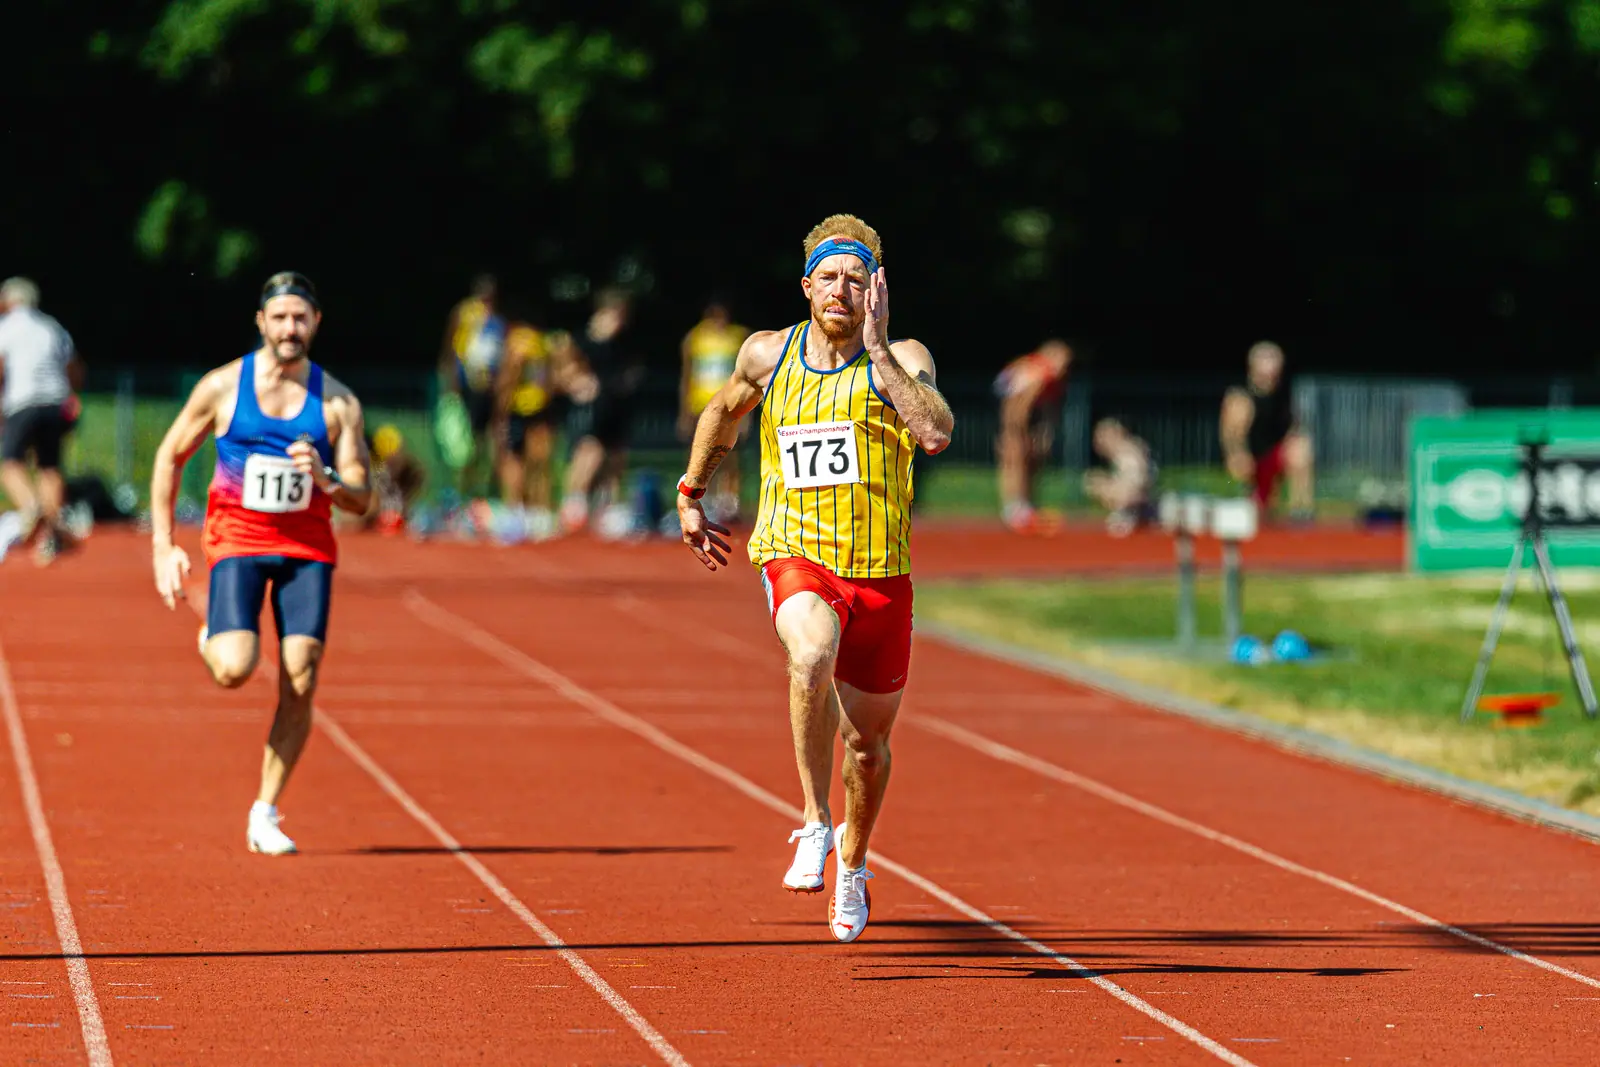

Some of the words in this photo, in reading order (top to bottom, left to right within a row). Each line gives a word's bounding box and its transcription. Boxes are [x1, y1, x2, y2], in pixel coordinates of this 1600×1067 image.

[781, 429, 798, 437] Essex
[800, 425, 850, 435] Championship
[786, 437, 850, 478] 173
[256, 472, 304, 503] 113
